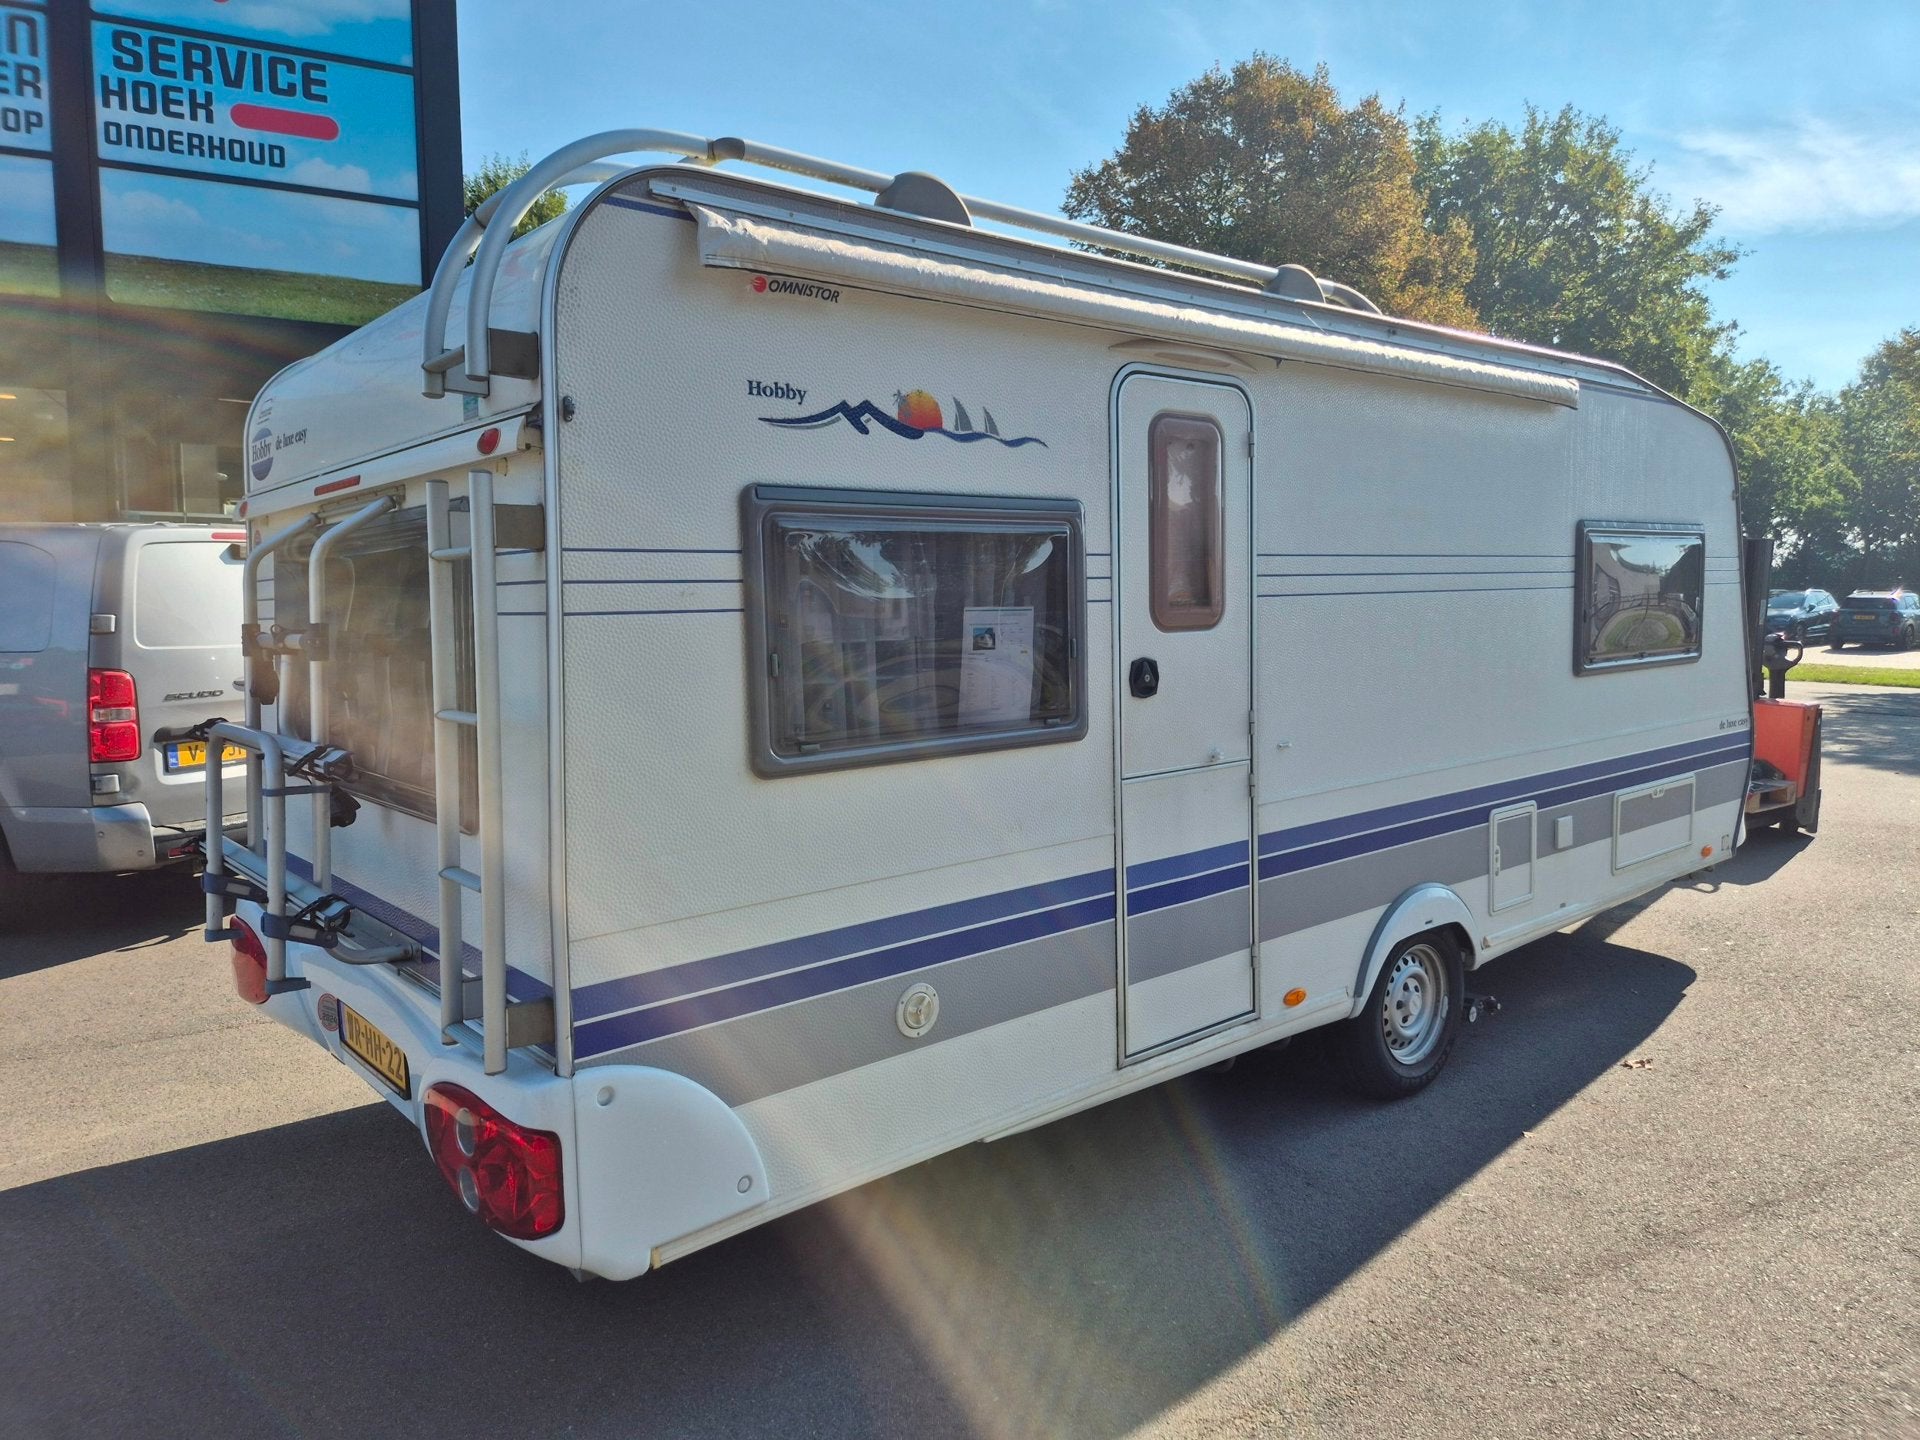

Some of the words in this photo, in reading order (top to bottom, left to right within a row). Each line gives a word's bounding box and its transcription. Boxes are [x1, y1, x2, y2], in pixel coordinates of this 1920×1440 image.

[112, 30, 328, 103] SERVICE
[102, 75, 214, 124] HOEK
[103, 121, 286, 168] ONDERHOUD
[767, 280, 840, 303] OMNISTOR
[747, 380, 807, 405] Hobby
[252, 440, 272, 462] Hobby
[163, 690, 224, 701] SCUDO
[346, 1011, 403, 1082] WR-HH-22
